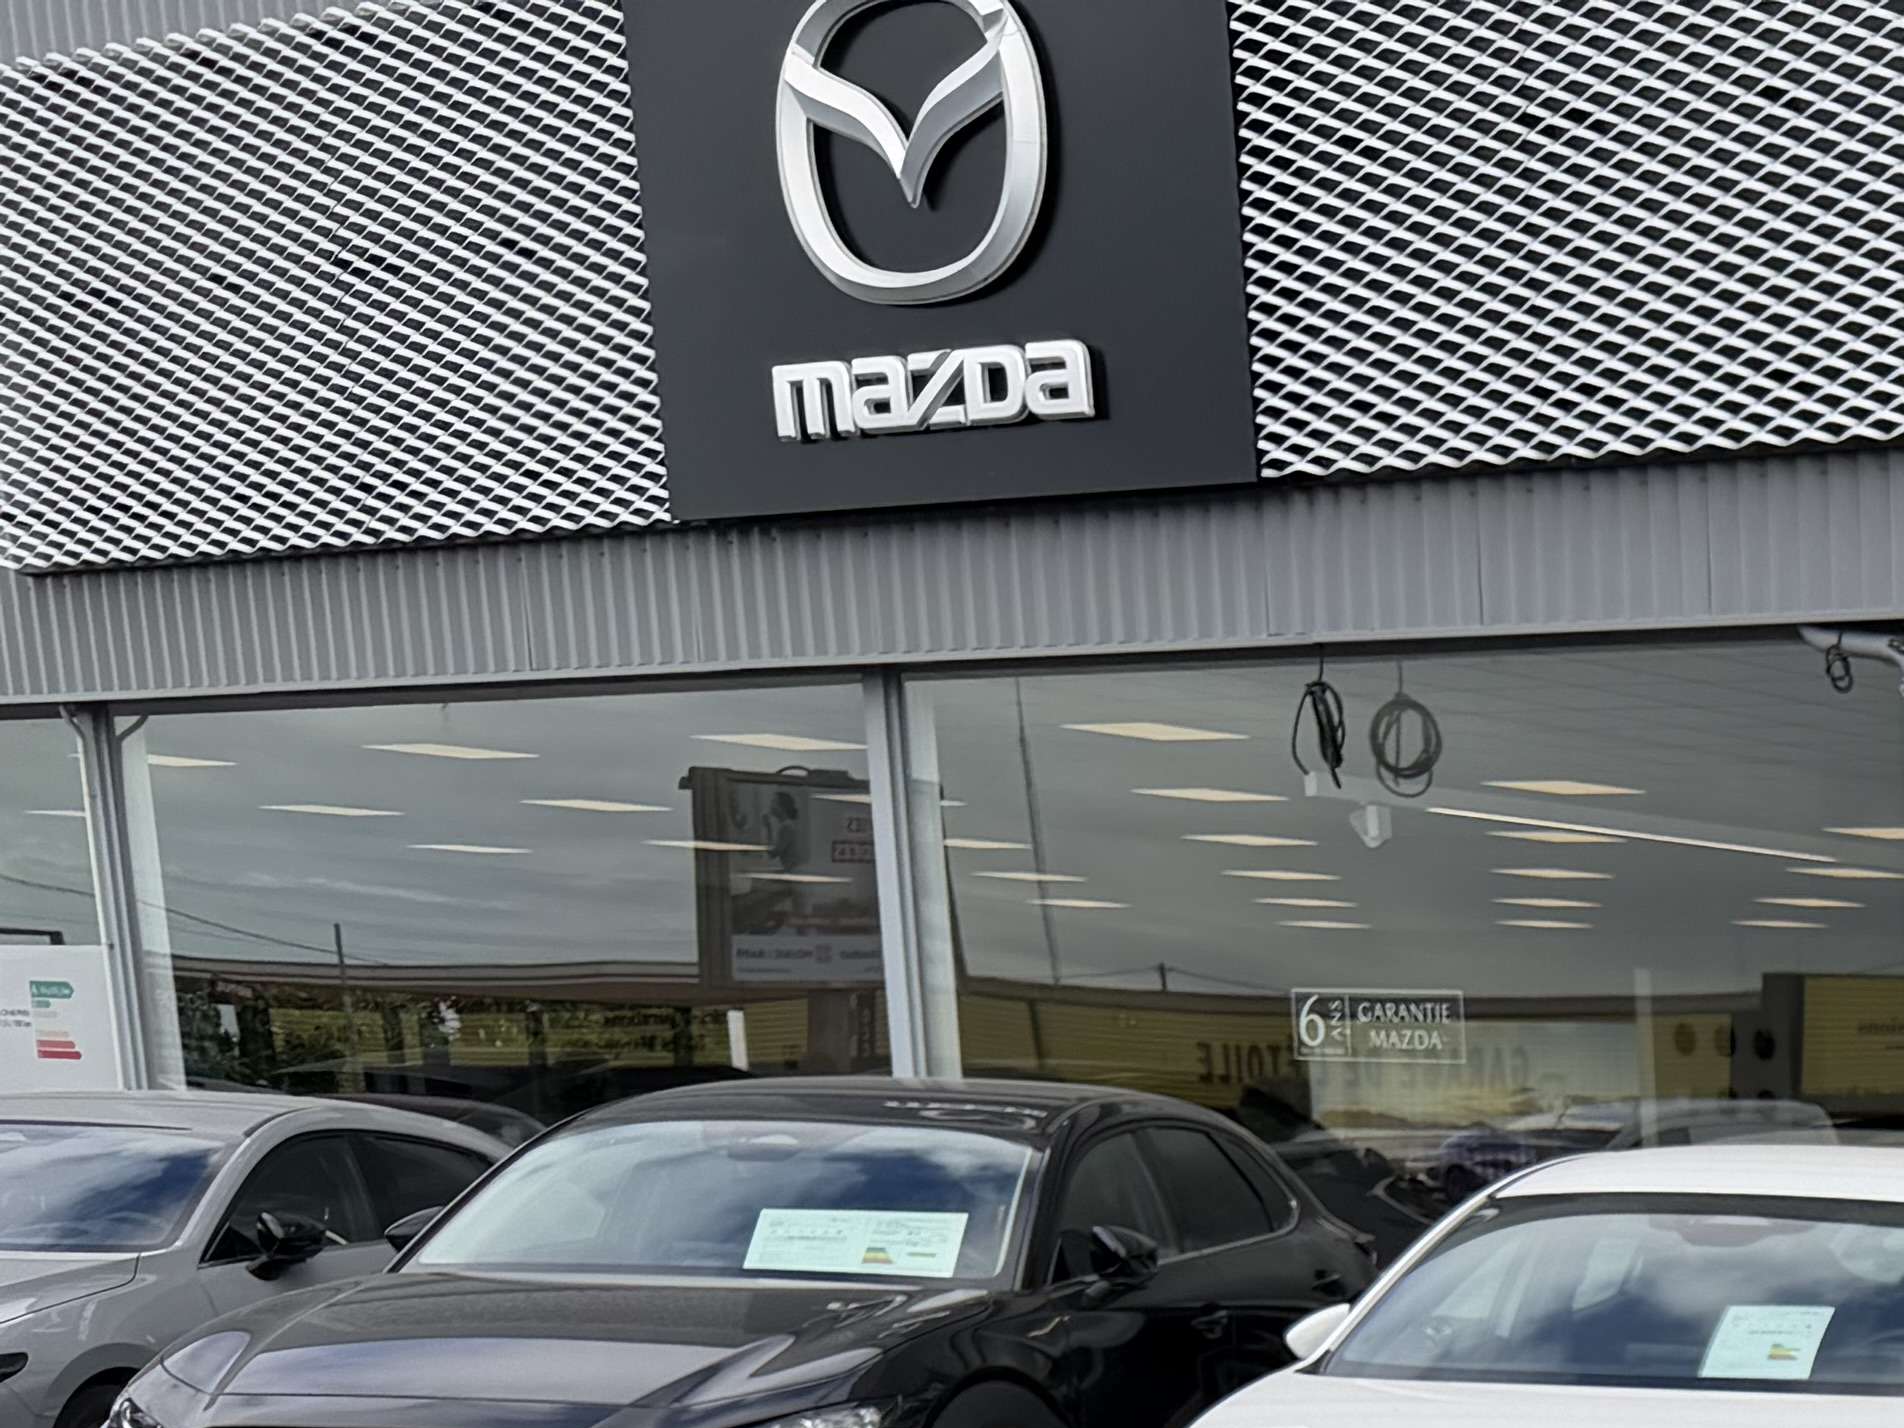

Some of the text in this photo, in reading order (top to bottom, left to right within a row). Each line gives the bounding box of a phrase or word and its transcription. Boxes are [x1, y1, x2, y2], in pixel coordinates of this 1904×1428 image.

[1299, 993, 1326, 1047] 6
[1356, 1001, 1452, 1025] GARANTIE
[1369, 1029, 1443, 1051] MAZDA
